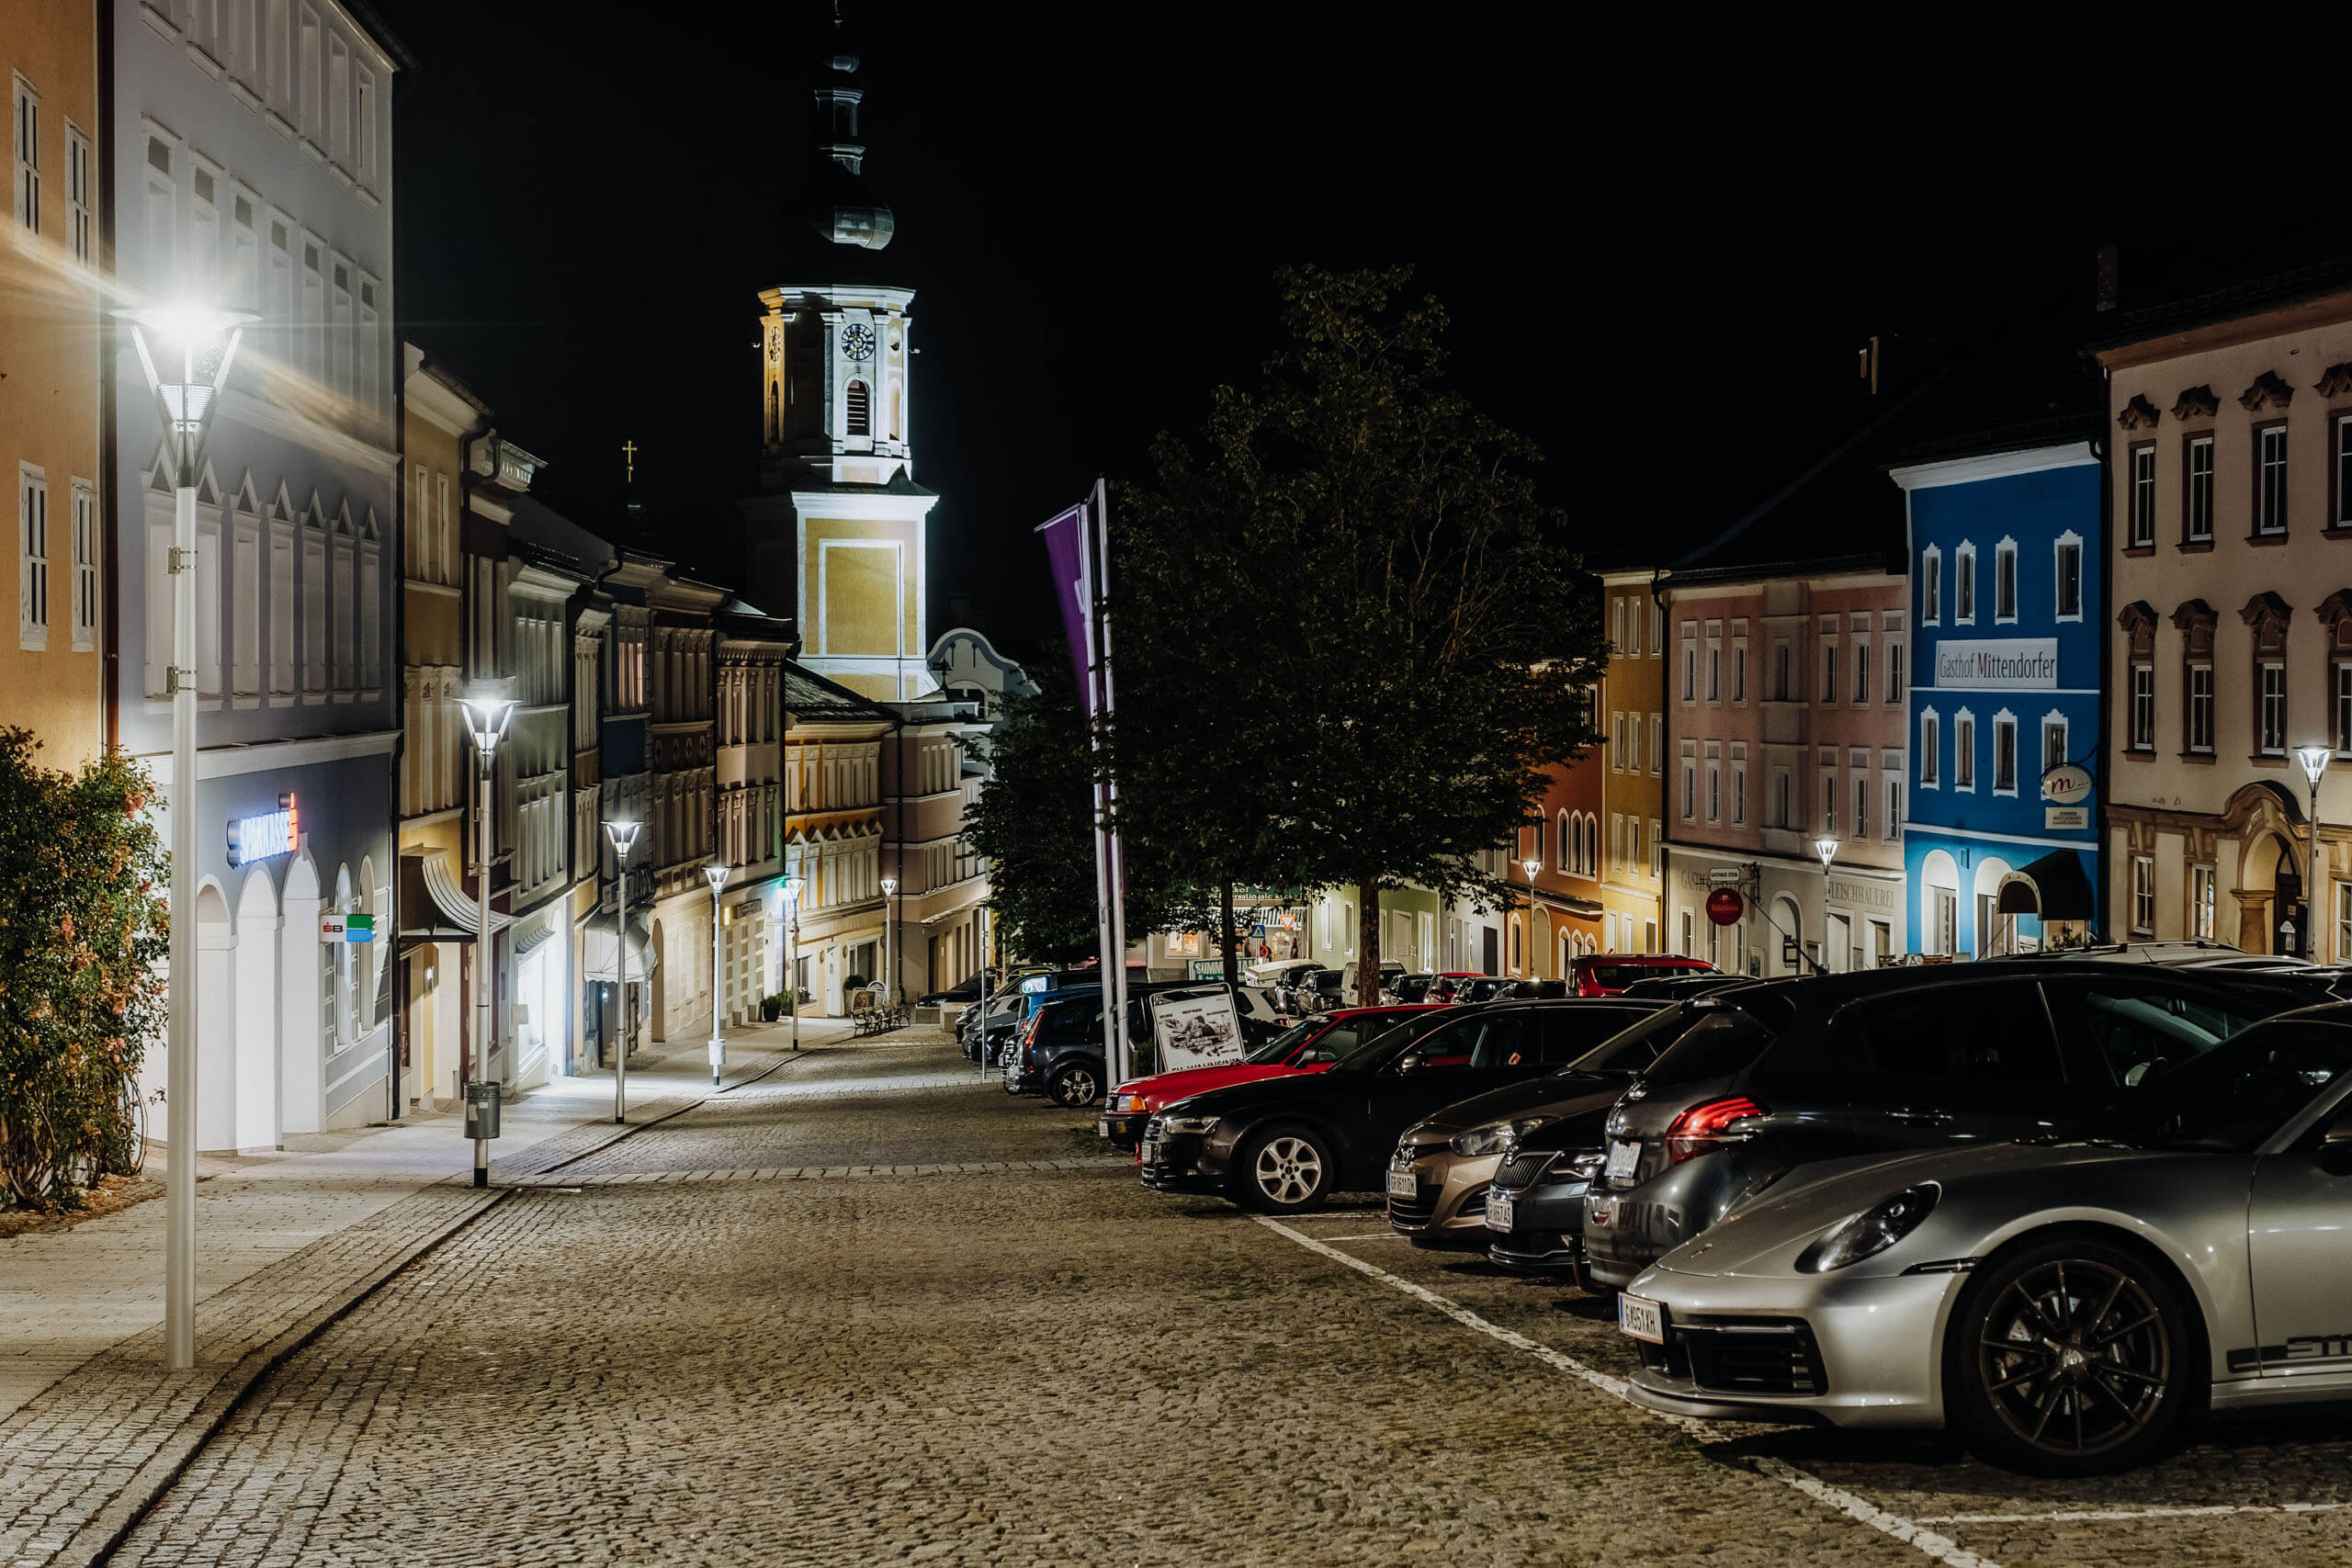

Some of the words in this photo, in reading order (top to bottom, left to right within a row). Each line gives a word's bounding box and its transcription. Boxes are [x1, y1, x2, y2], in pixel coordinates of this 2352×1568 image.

[1939, 635, 1975, 678] Gasthof
[1977, 632, 2055, 679] Mittendorfer
[1829, 881, 1895, 908] LEISCHHAUEREI
